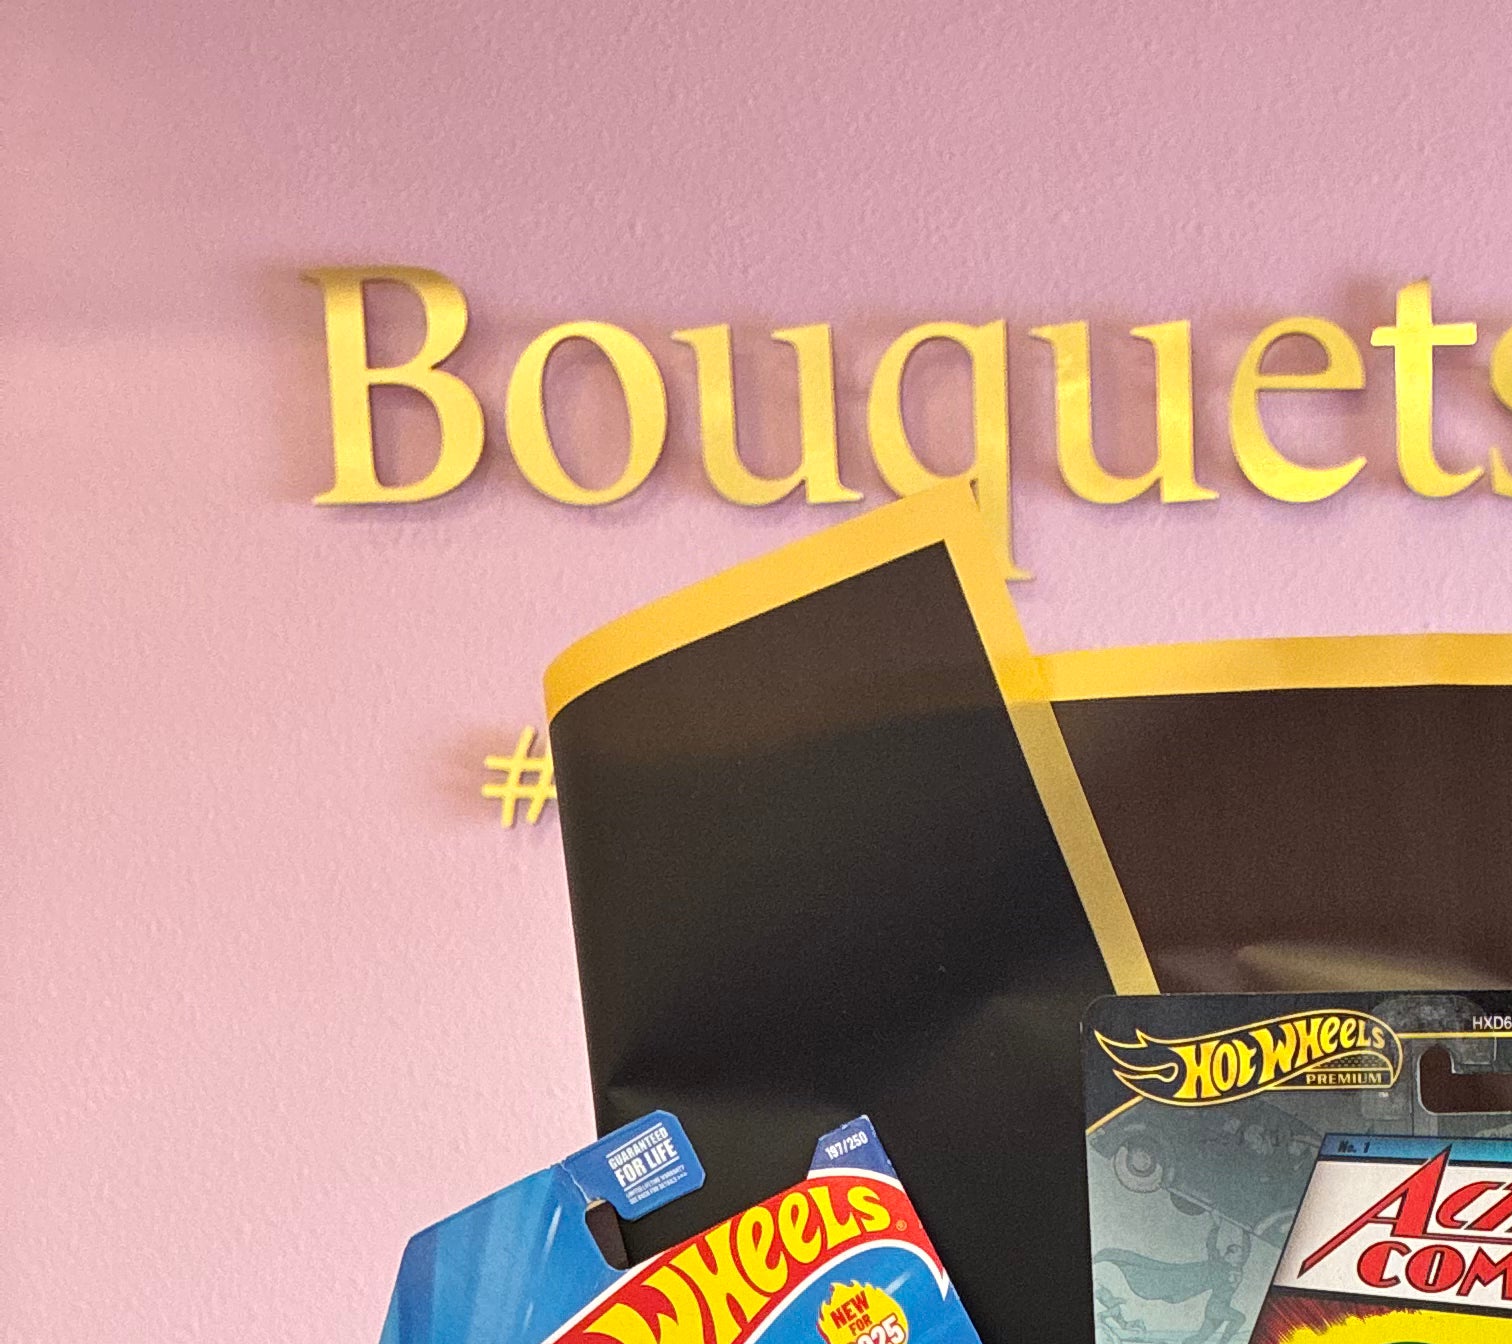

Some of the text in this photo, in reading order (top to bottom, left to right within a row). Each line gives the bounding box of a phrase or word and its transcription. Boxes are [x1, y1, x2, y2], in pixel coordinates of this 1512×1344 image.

[1306, 1072, 1382, 1085] PREMIUM
[608, 1127, 669, 1170] GUARANTEED
[825, 1131, 869, 1161] 197/250
[614, 1139, 678, 1188] FOR LIFE
[829, 1290, 870, 1329] NEW
[849, 1314, 873, 1337] FOR
